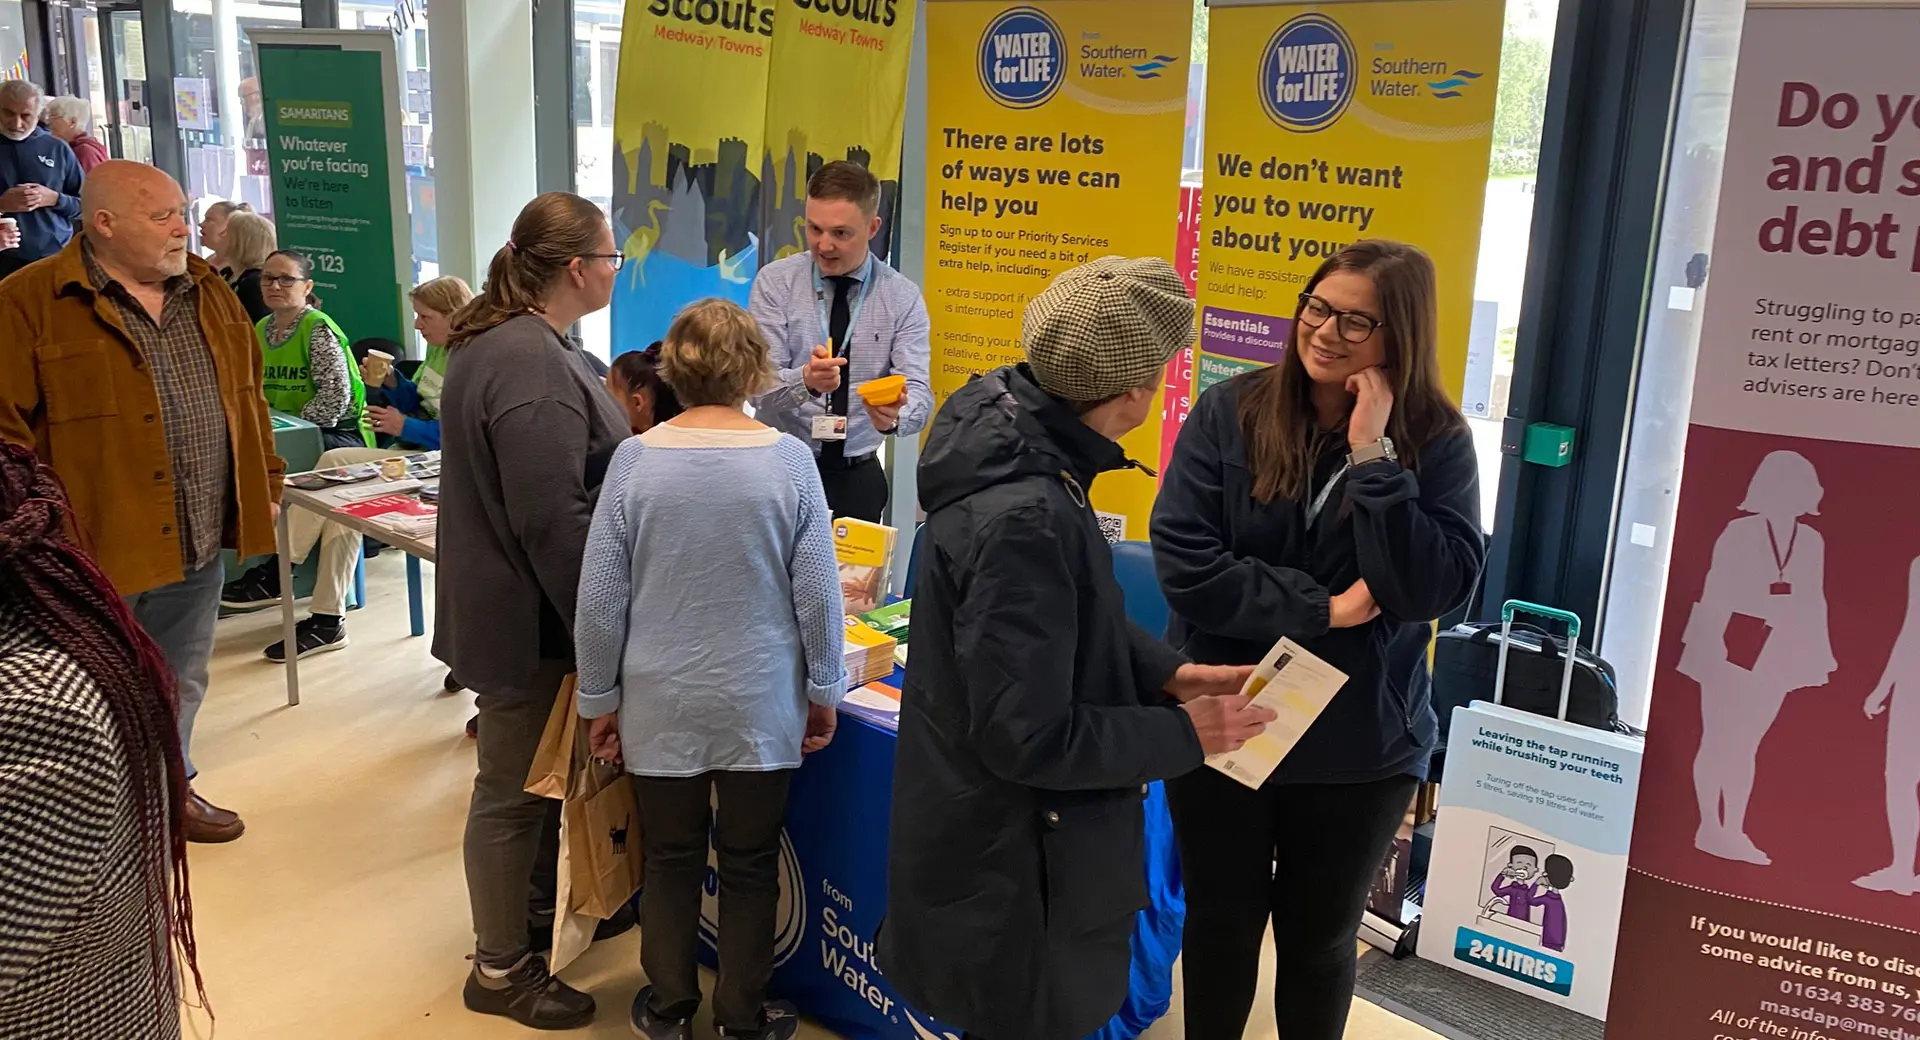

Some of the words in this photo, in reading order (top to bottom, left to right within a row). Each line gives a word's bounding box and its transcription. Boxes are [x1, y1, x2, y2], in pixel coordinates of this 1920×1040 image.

[654, 24, 713, 50] Medway
[718, 36, 764, 57] Towns
[800, 19, 845, 44] Medway
[850, 29, 884, 52] Towns
[994, 32, 1050, 58] WATER
[1081, 45, 1146, 59] Southern
[1278, 43, 1339, 74] WATER
[994, 62, 1018, 83] for
[1372, 58, 1446, 74] Southern
[1276, 76, 1302, 103] for
[280, 107, 348, 120] SAMARITANS
[1778, 82, 1859, 129] Do
[280, 136, 348, 152] Whatever
[944, 128, 1007, 150] There
[1015, 135, 1053, 152] are
[1061, 132, 1104, 154] lots
[281, 157, 323, 172] you're
[327, 159, 368, 177] facing
[942, 160, 963, 179] of
[970, 165, 1029, 188] ways
[1038, 168, 1070, 185] we
[1078, 170, 1120, 188] can
[1218, 154, 1252, 178] We
[1260, 158, 1328, 183] don't
[1337, 166, 1403, 188] want
[1766, 146, 1886, 194] and
[284, 177, 319, 190] We're
[324, 180, 349, 192] here
[286, 196, 298, 208] to
[302, 197, 332, 210] listen
[941, 190, 987, 216] help
[994, 198, 1038, 218] you
[1214, 194, 1255, 217] you
[1265, 195, 1289, 217] to
[1300, 200, 1374, 231] worry
[940, 224, 961, 238] Sign
[965, 227, 978, 239] up
[981, 227, 992, 238] to
[996, 230, 1014, 240] our
[1018, 230, 1058, 246] Priority
[1062, 233, 1108, 248] Services
[1212, 226, 1280, 253] about
[1758, 206, 1900, 258] debt
[318, 254, 344, 273] 123
[940, 241, 981, 255] Register
[984, 244, 992, 254] if
[995, 246, 1015, 258] you
[1020, 246, 1046, 260] need
[1050, 251, 1056, 260] a
[1060, 250, 1074, 262] bit
[1078, 252, 1088, 263] of
[939, 259, 962, 269] extra
[966, 260, 992, 273] help,
[996, 263, 1050, 278] including:
[1209, 261, 1224, 273] We
[1227, 263, 1254, 277] have
[946, 288, 970, 298] extra
[973, 291, 1014, 302] support
[1018, 294, 1024, 303] if
[1208, 281, 1234, 296] could
[1238, 284, 1266, 300] help:
[945, 304, 952, 312] is
[956, 304, 1014, 319] interrupted
[1205, 313, 1270, 335] Essentials
[1754, 298, 1866, 326] Struggling
[1872, 308, 1894, 324] to
[944, 332, 984, 346] sending
[988, 337, 1010, 348] your
[1204, 327, 1236, 343] Provides
[1245, 333, 1283, 350] discount
[1751, 328, 1794, 343] rent
[1799, 332, 1822, 344] or
[944, 347, 982, 362] relative,
[986, 353, 997, 362] or
[1202, 358, 1246, 377] WaterS
[1748, 352, 1779, 368] tax
[1784, 353, 1860, 374] letters?
[1743, 377, 1827, 399] advisers
[1832, 387, 1866, 402] are
[1872, 386, 1919, 406] here
[1472, 737, 1502, 752] while
[1505, 745, 1556, 769] brushing
[1560, 760, 1588, 776] your
[1590, 767, 1623, 784] teeth
[1479, 726, 1523, 747] Leaving
[1526, 739, 1546, 752] the
[1548, 745, 1568, 759] tap
[1572, 752, 1620, 772] running
[1476, 780, 1482, 788] 5
[1507, 788, 1534, 804] saving
[1536, 796, 1545, 804] 19
[1546, 799, 1567, 812] litres
[1568, 805, 1578, 814] of
[1513, 780, 1524, 789] off
[1526, 784, 1540, 794] the
[1542, 788, 1555, 800] tap
[1558, 794, 1576, 804] uses
[1578, 798, 1598, 811] only
[822, 878, 852, 912] from
[822, 906, 882, 975] Sout
[1690, 915, 1706, 931] If
[1708, 922, 1745, 940] you
[1750, 930, 1812, 953] would
[1816, 941, 1853, 962] like
[1858, 951, 1880, 967] to
[1469, 940, 1494, 963] 24
[1497, 947, 1557, 984] LITRES
[1700, 942, 1754, 964] some
[1758, 956, 1823, 978] advice
[1828, 967, 1876, 990] from
[1882, 982, 1911, 1000] us,
[1780, 980, 1842, 1005] 01634
[1846, 995, 1885, 1014] 383
[1710, 1010, 1735, 1025] All
[1737, 1016, 1759, 1030] of
[1759, 1020, 1788, 1037] the
